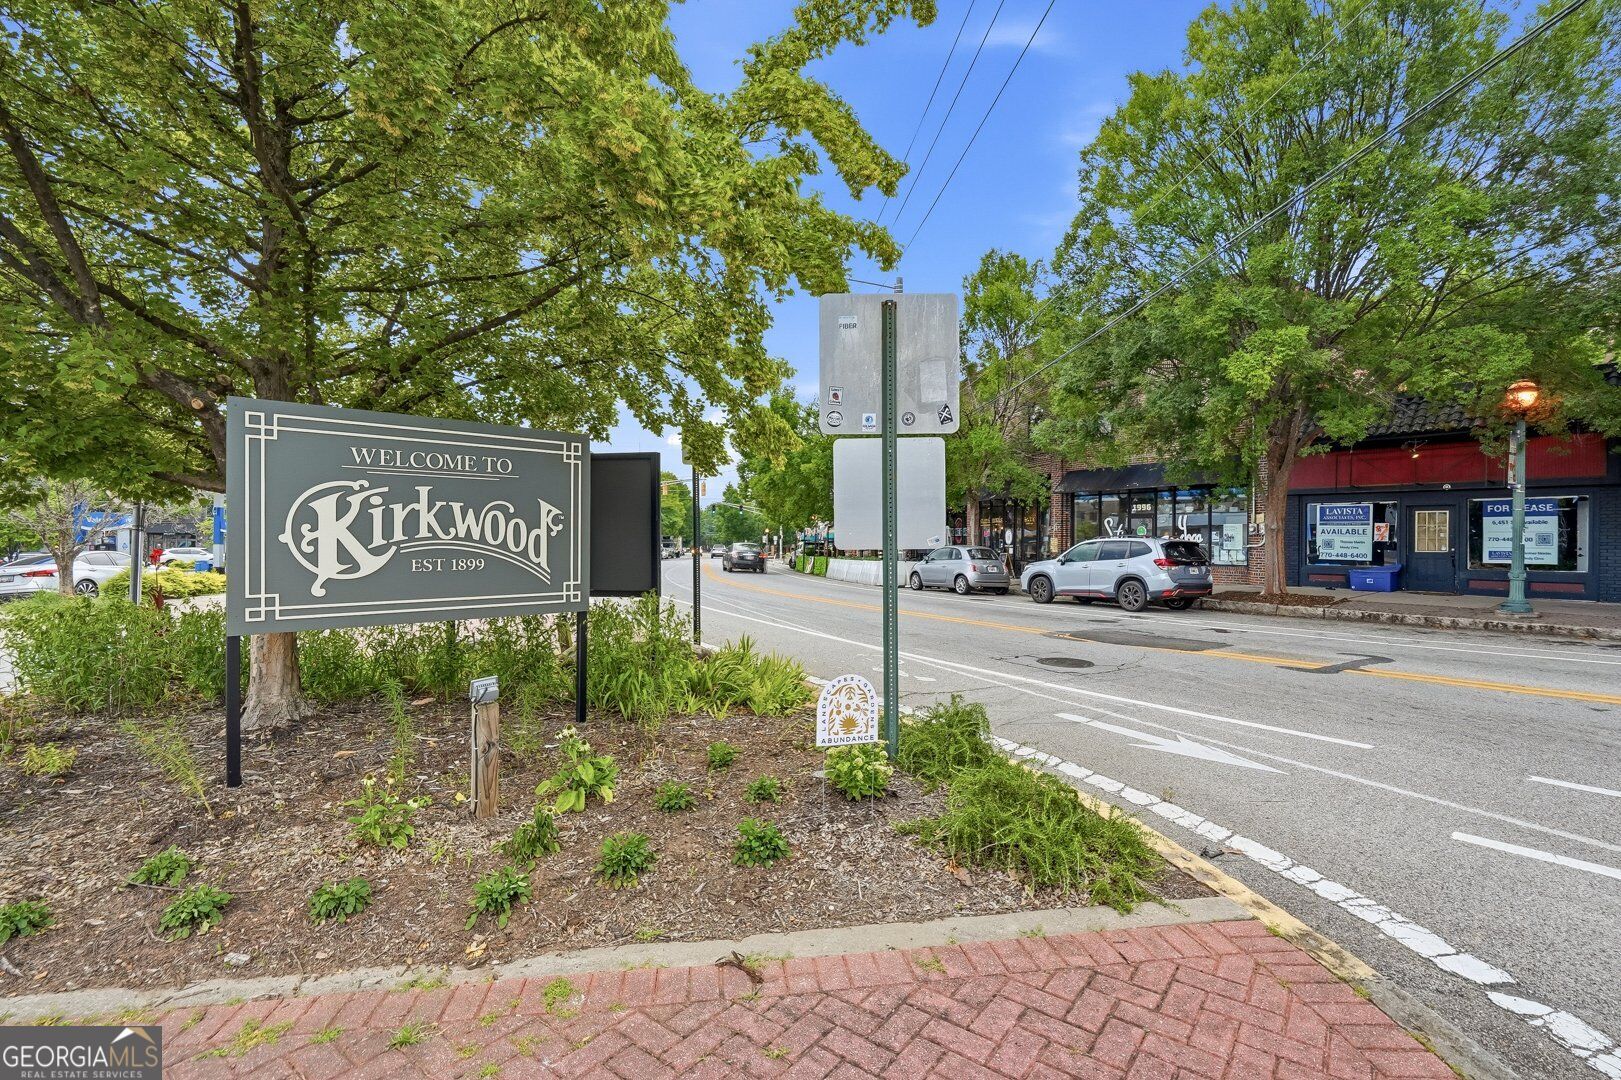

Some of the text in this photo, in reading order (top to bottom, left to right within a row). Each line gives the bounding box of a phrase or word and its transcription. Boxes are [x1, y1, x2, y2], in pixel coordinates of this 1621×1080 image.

[349, 446, 513, 475] WELCOME TO
[277, 479, 564, 598] Kirkwood
[411, 557, 485, 573] EST 1899
[822, 677, 854, 731] LANDSCAPES
[821, 735, 874, 744] ABUNDANCE
